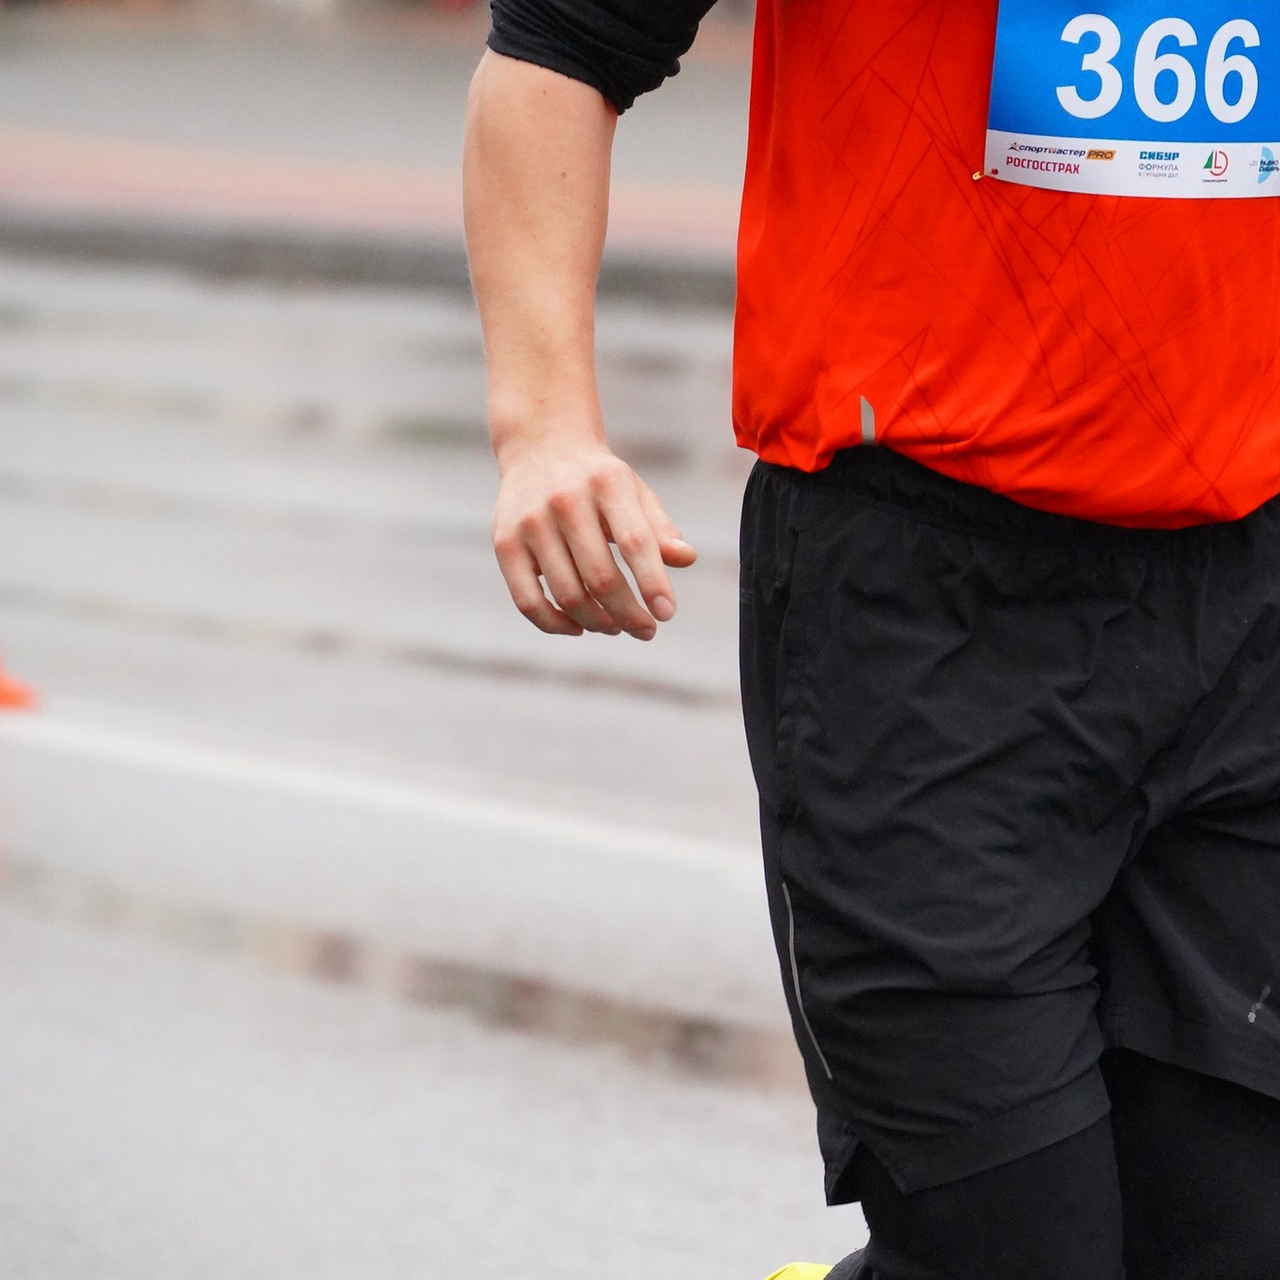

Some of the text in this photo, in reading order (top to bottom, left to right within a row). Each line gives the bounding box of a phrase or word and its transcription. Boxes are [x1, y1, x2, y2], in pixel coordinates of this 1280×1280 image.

[1056, 13, 1261, 124] 366
[1087, 150, 1115, 160] PRO
[1139, 151, 1180, 161] СИБУР
[1006, 156, 1080, 174] РОСГОССТРАХ
[1138, 163, 1179, 172] ФОРМУЛА
